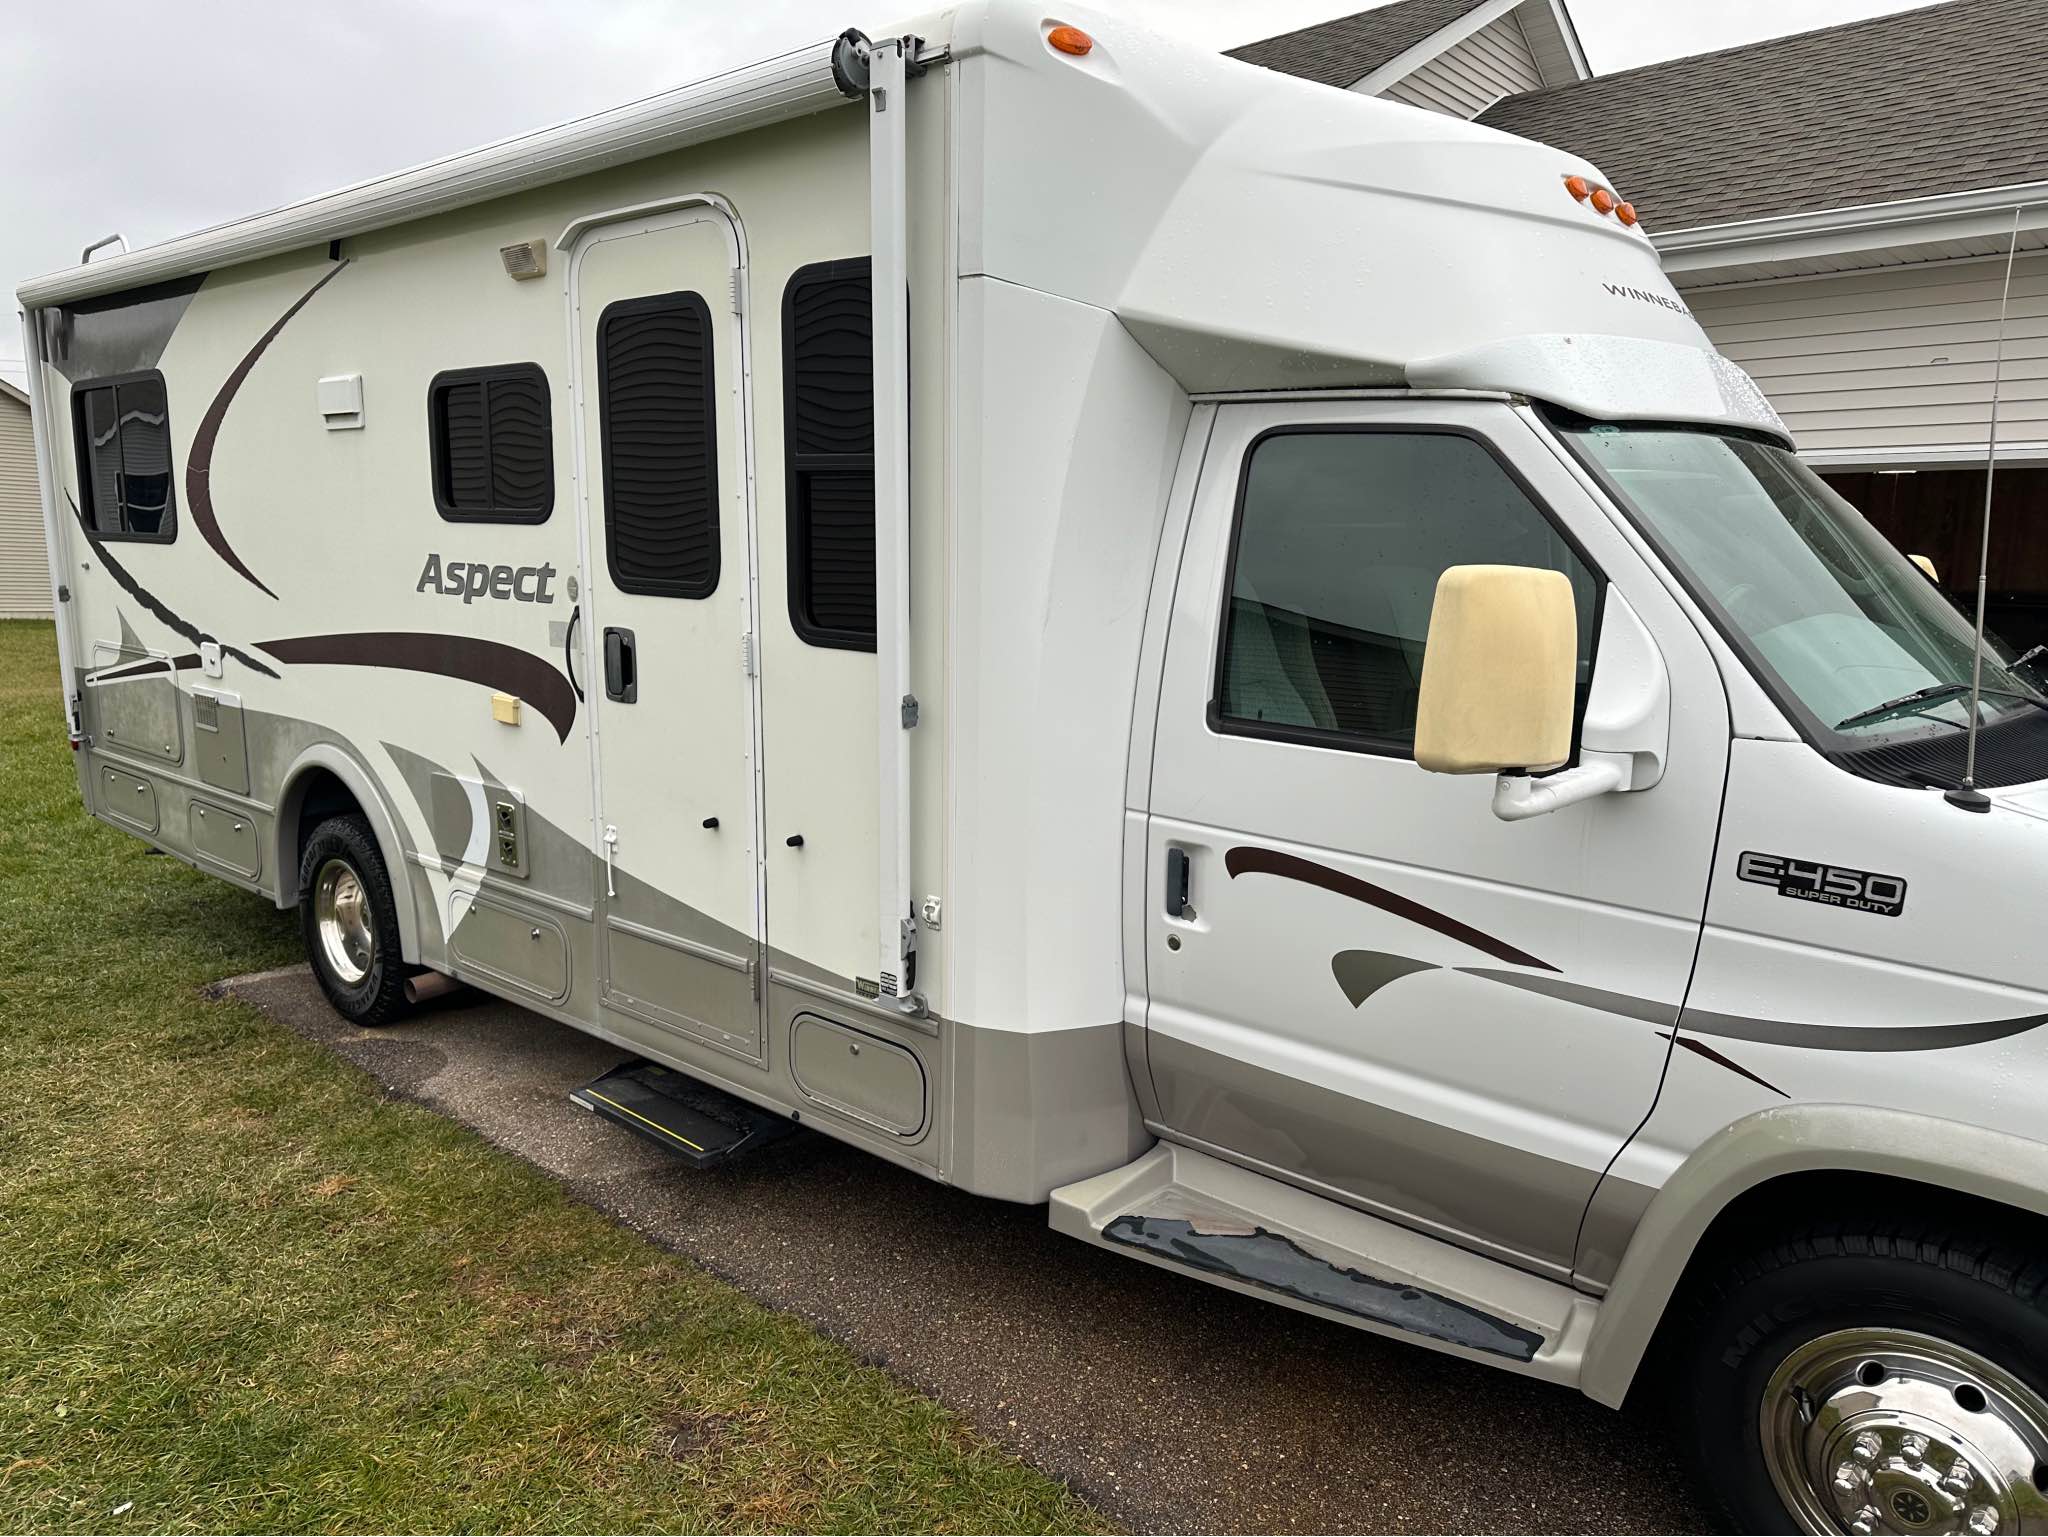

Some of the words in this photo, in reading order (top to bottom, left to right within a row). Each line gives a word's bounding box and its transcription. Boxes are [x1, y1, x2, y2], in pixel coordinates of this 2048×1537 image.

[416, 553, 557, 605] Aspect
[1739, 853, 1904, 904] E-450
[1785, 887, 1841, 904] SUPER
[1846, 898, 1894, 913] DUTY
